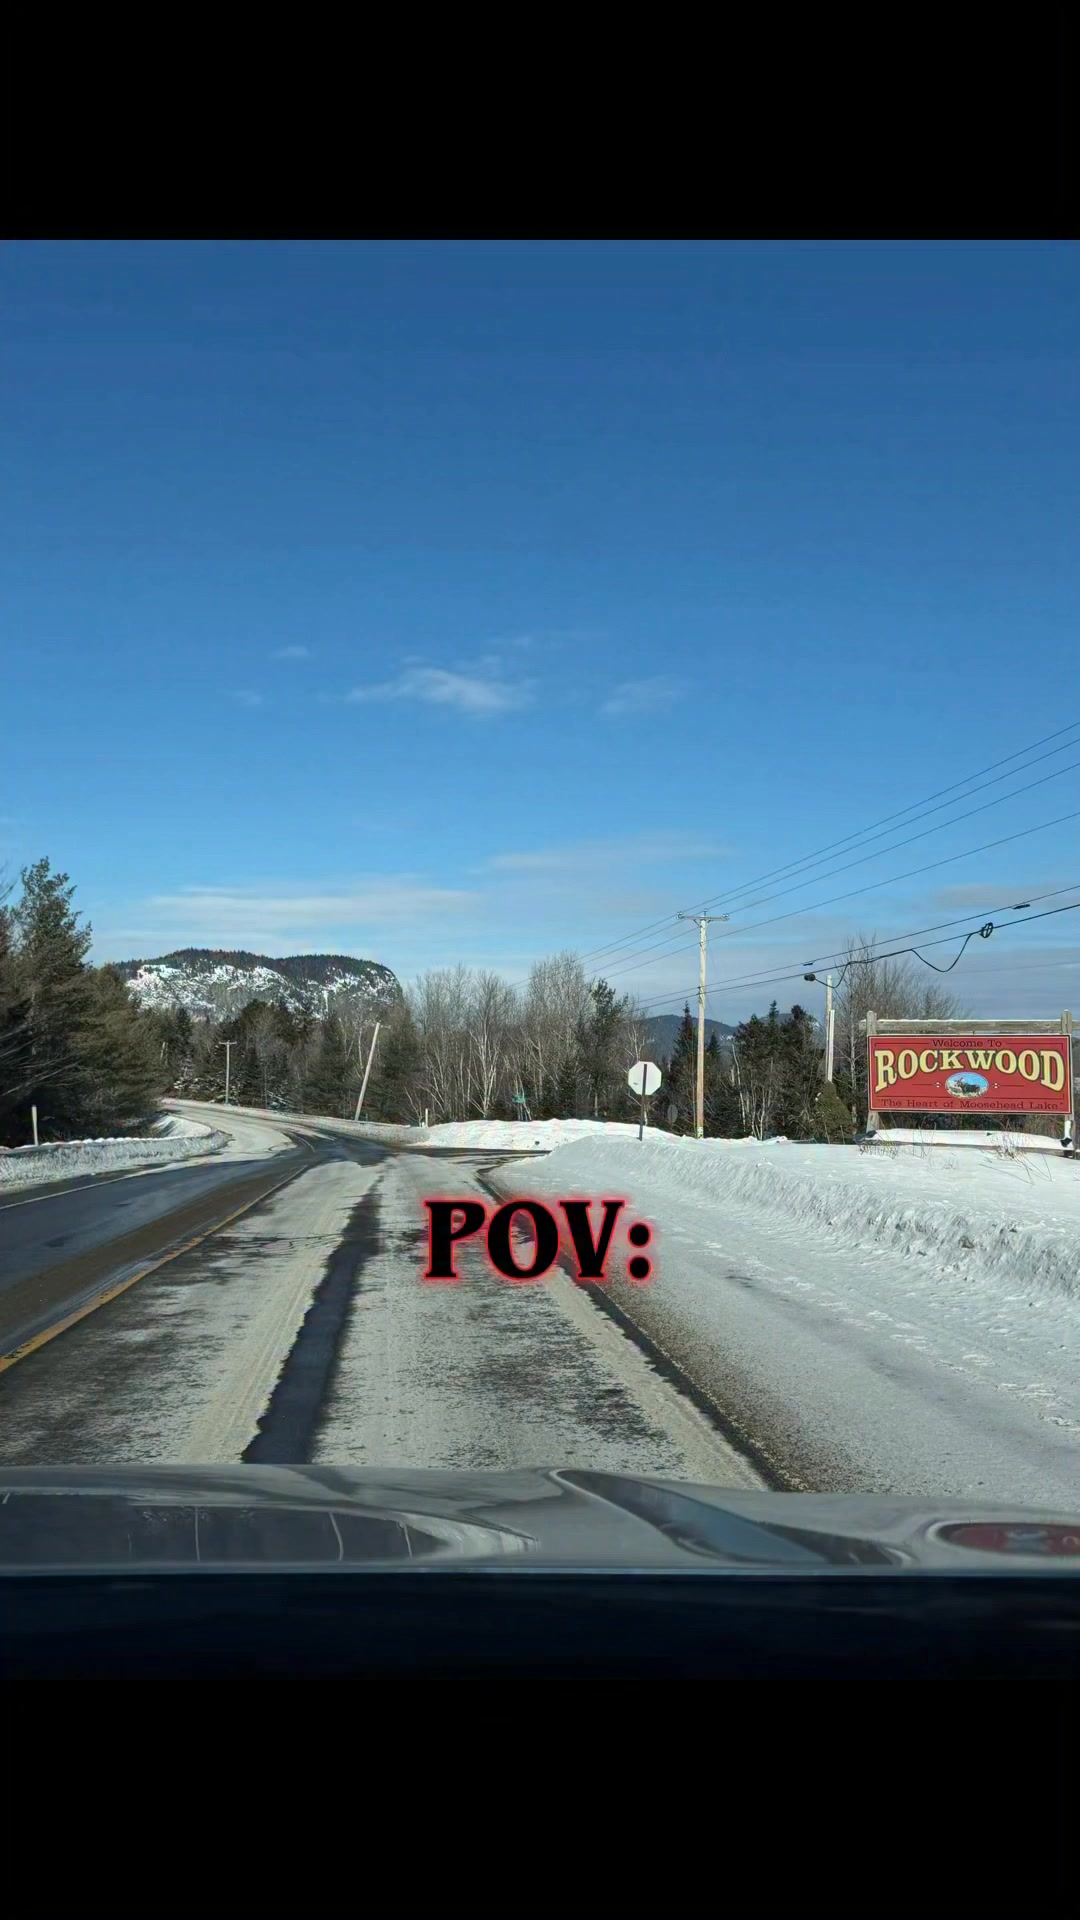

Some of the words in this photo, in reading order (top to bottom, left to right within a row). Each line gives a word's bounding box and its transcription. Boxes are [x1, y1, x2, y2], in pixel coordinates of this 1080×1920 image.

[932, 1039, 983, 1048] Welcome
[987, 1039, 1002, 1048] To
[874, 1049, 1065, 1093] ROCKWOOD
[907, 1099, 938, 1108] Heart
[943, 1100, 954, 1108] of
[960, 1100, 1024, 1110] Moosehead
